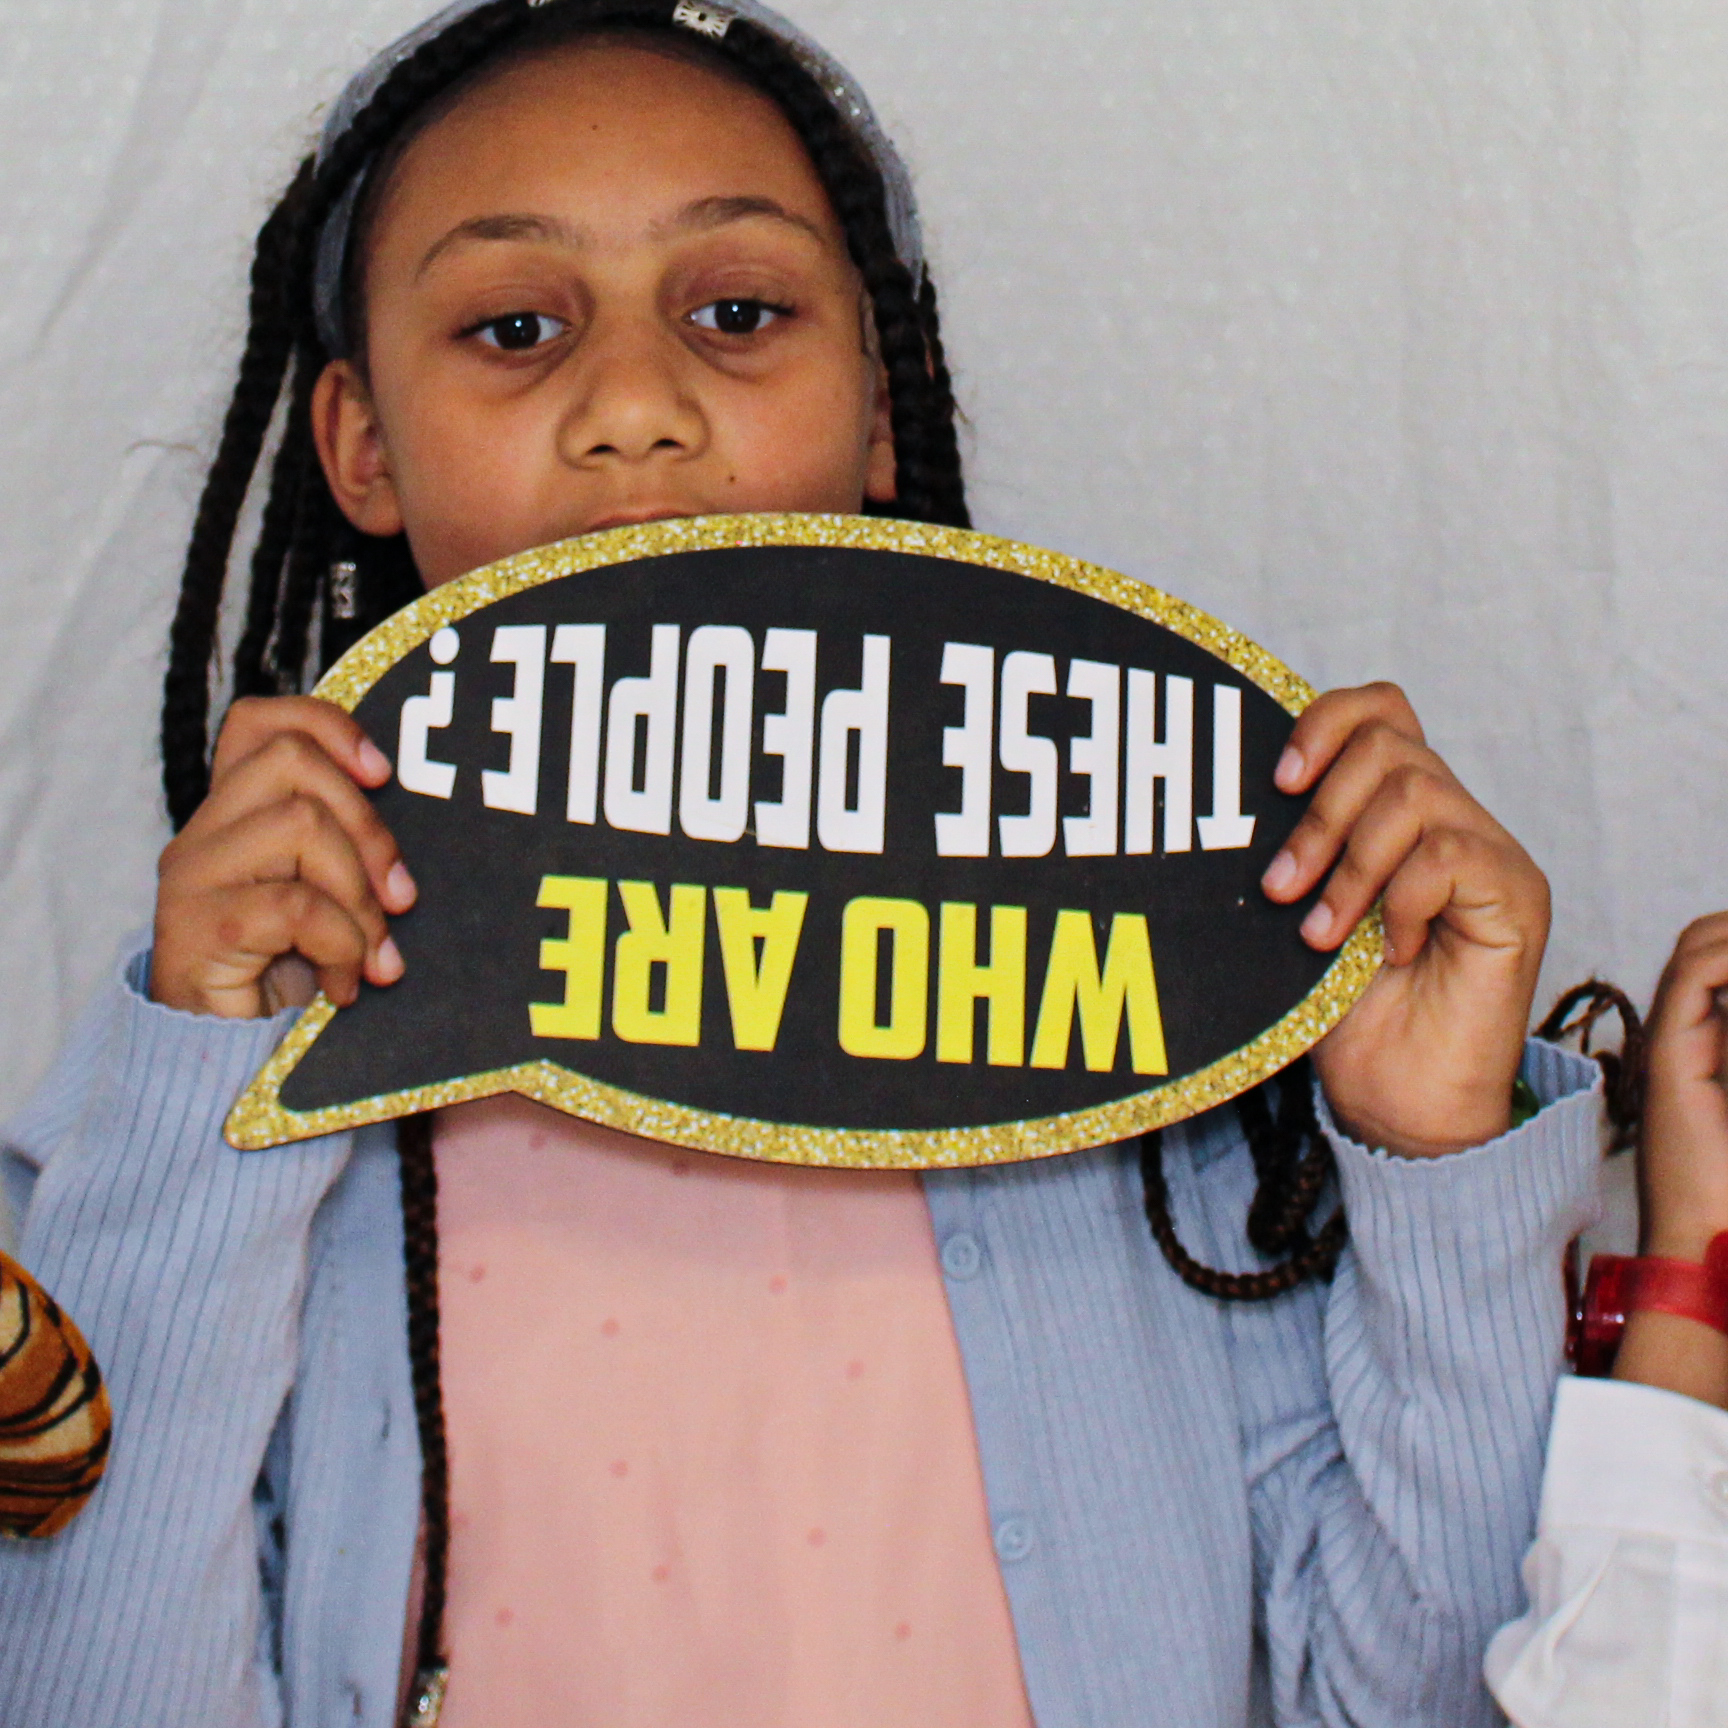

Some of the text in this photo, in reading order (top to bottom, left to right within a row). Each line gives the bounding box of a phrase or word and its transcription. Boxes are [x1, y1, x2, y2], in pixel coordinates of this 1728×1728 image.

[397, 623, 1256, 858] THESE PEOPLE?
[528, 874, 1169, 1076] WHO ARE
